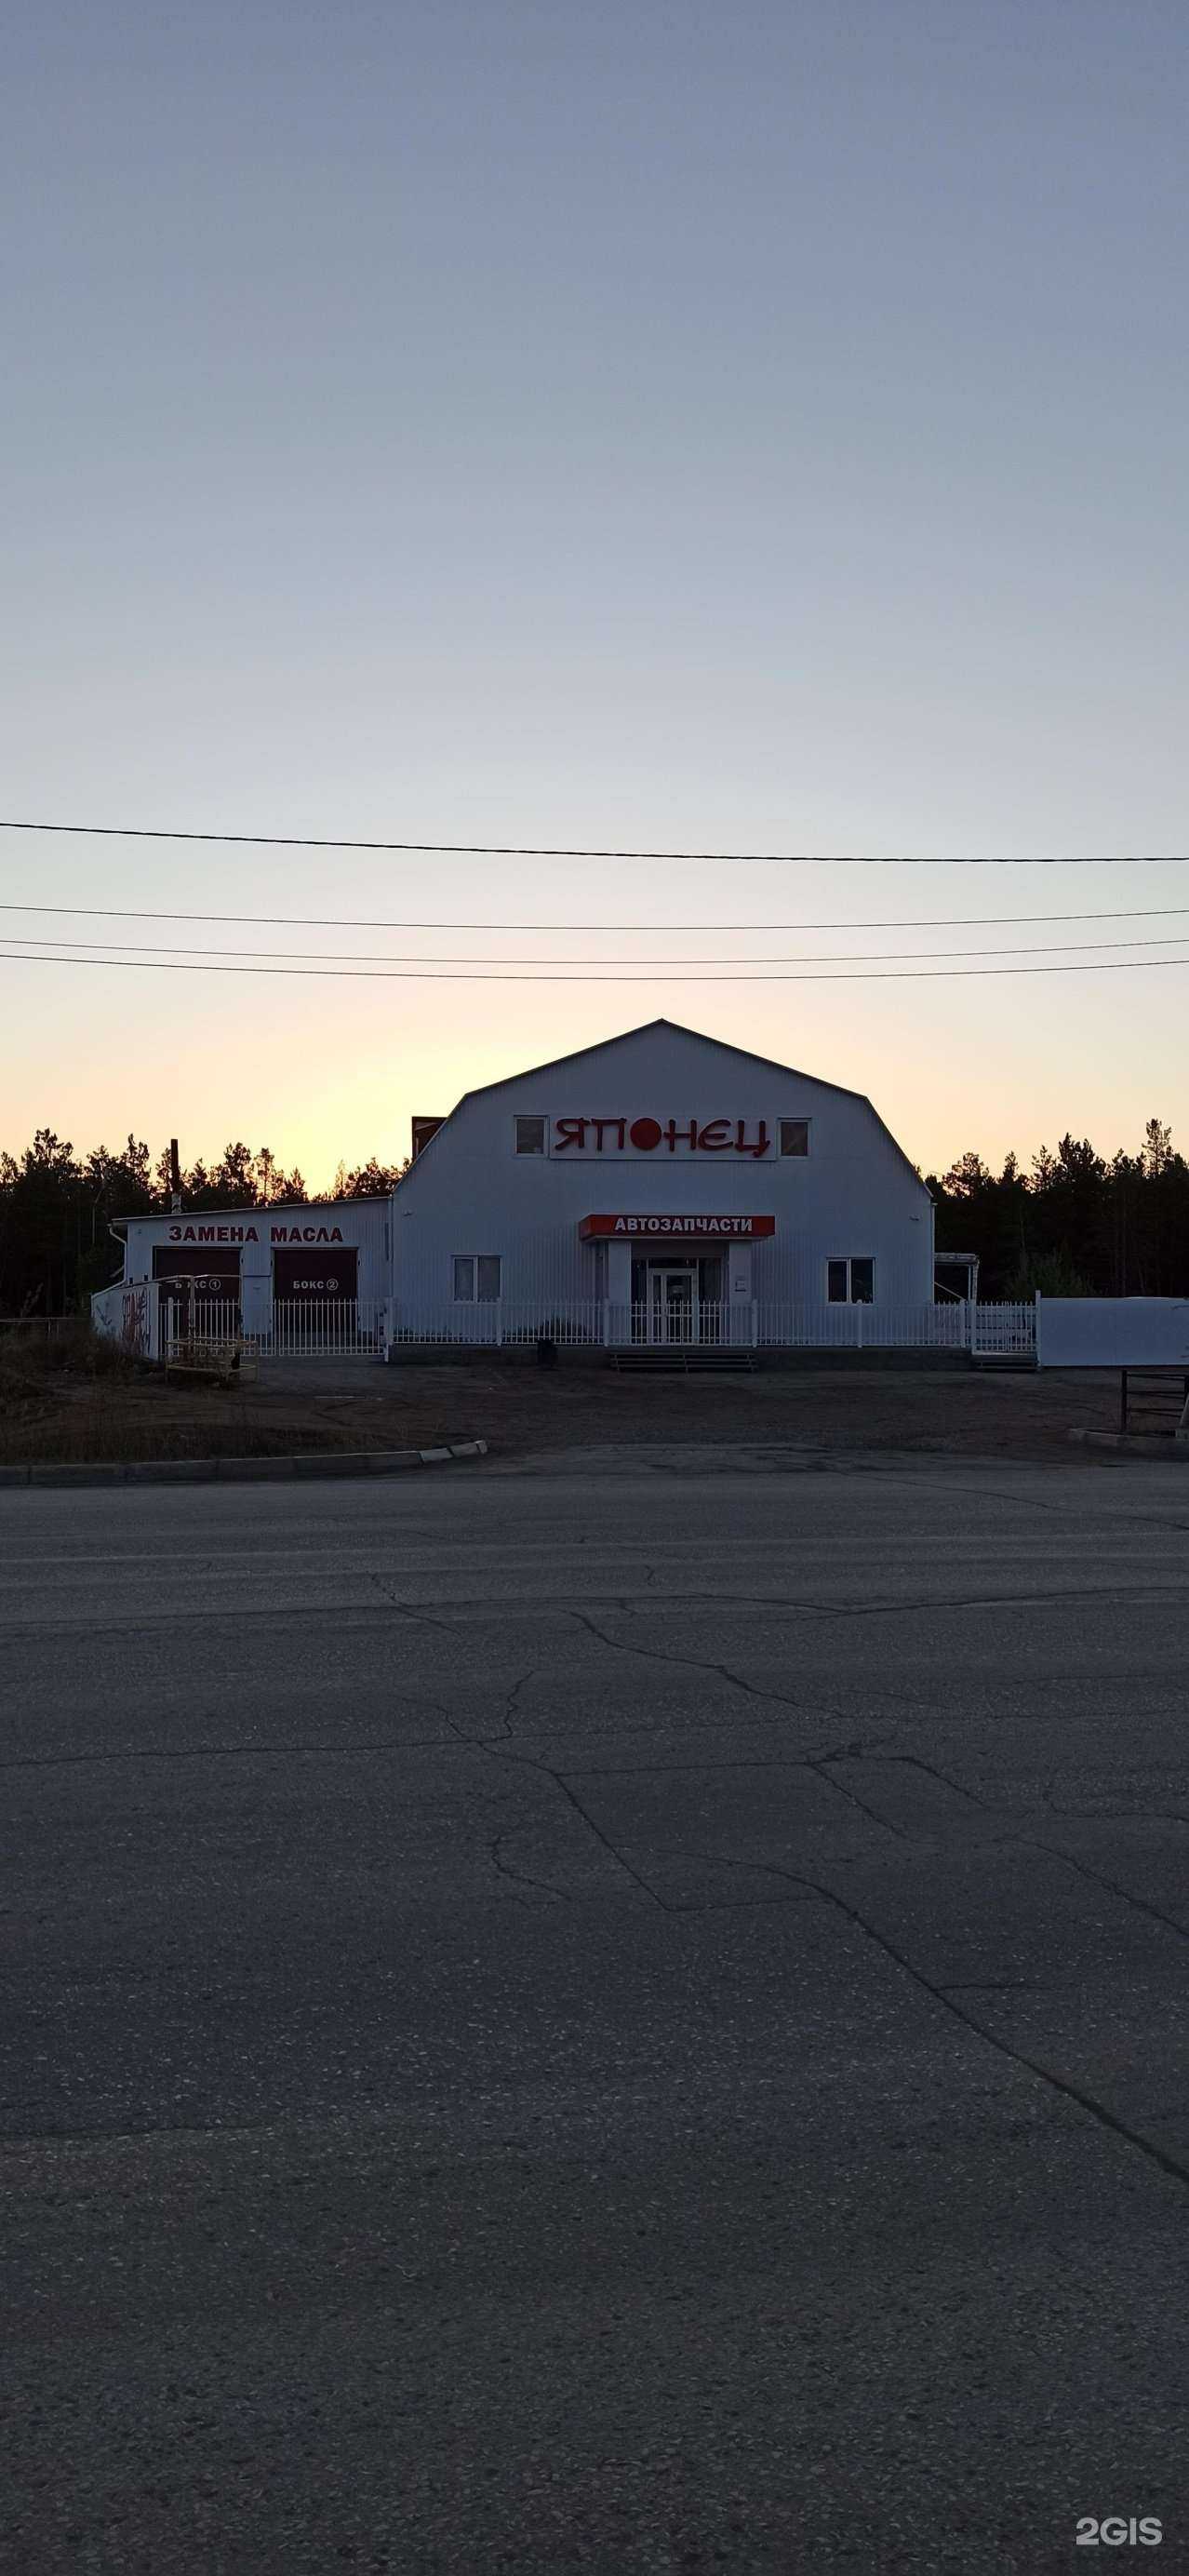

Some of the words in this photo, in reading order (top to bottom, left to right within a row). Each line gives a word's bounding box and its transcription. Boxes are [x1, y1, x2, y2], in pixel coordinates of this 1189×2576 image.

[555, 1118, 770, 1158] ЯПОНЕЦ
[614, 1217, 752, 1232] АВТОЗАПЧАСТИ
[169, 1226, 259, 1242] ЗАМЕНА
[271, 1227, 343, 1242] МАСЛА
[292, 1280, 325, 1289] БОКС
